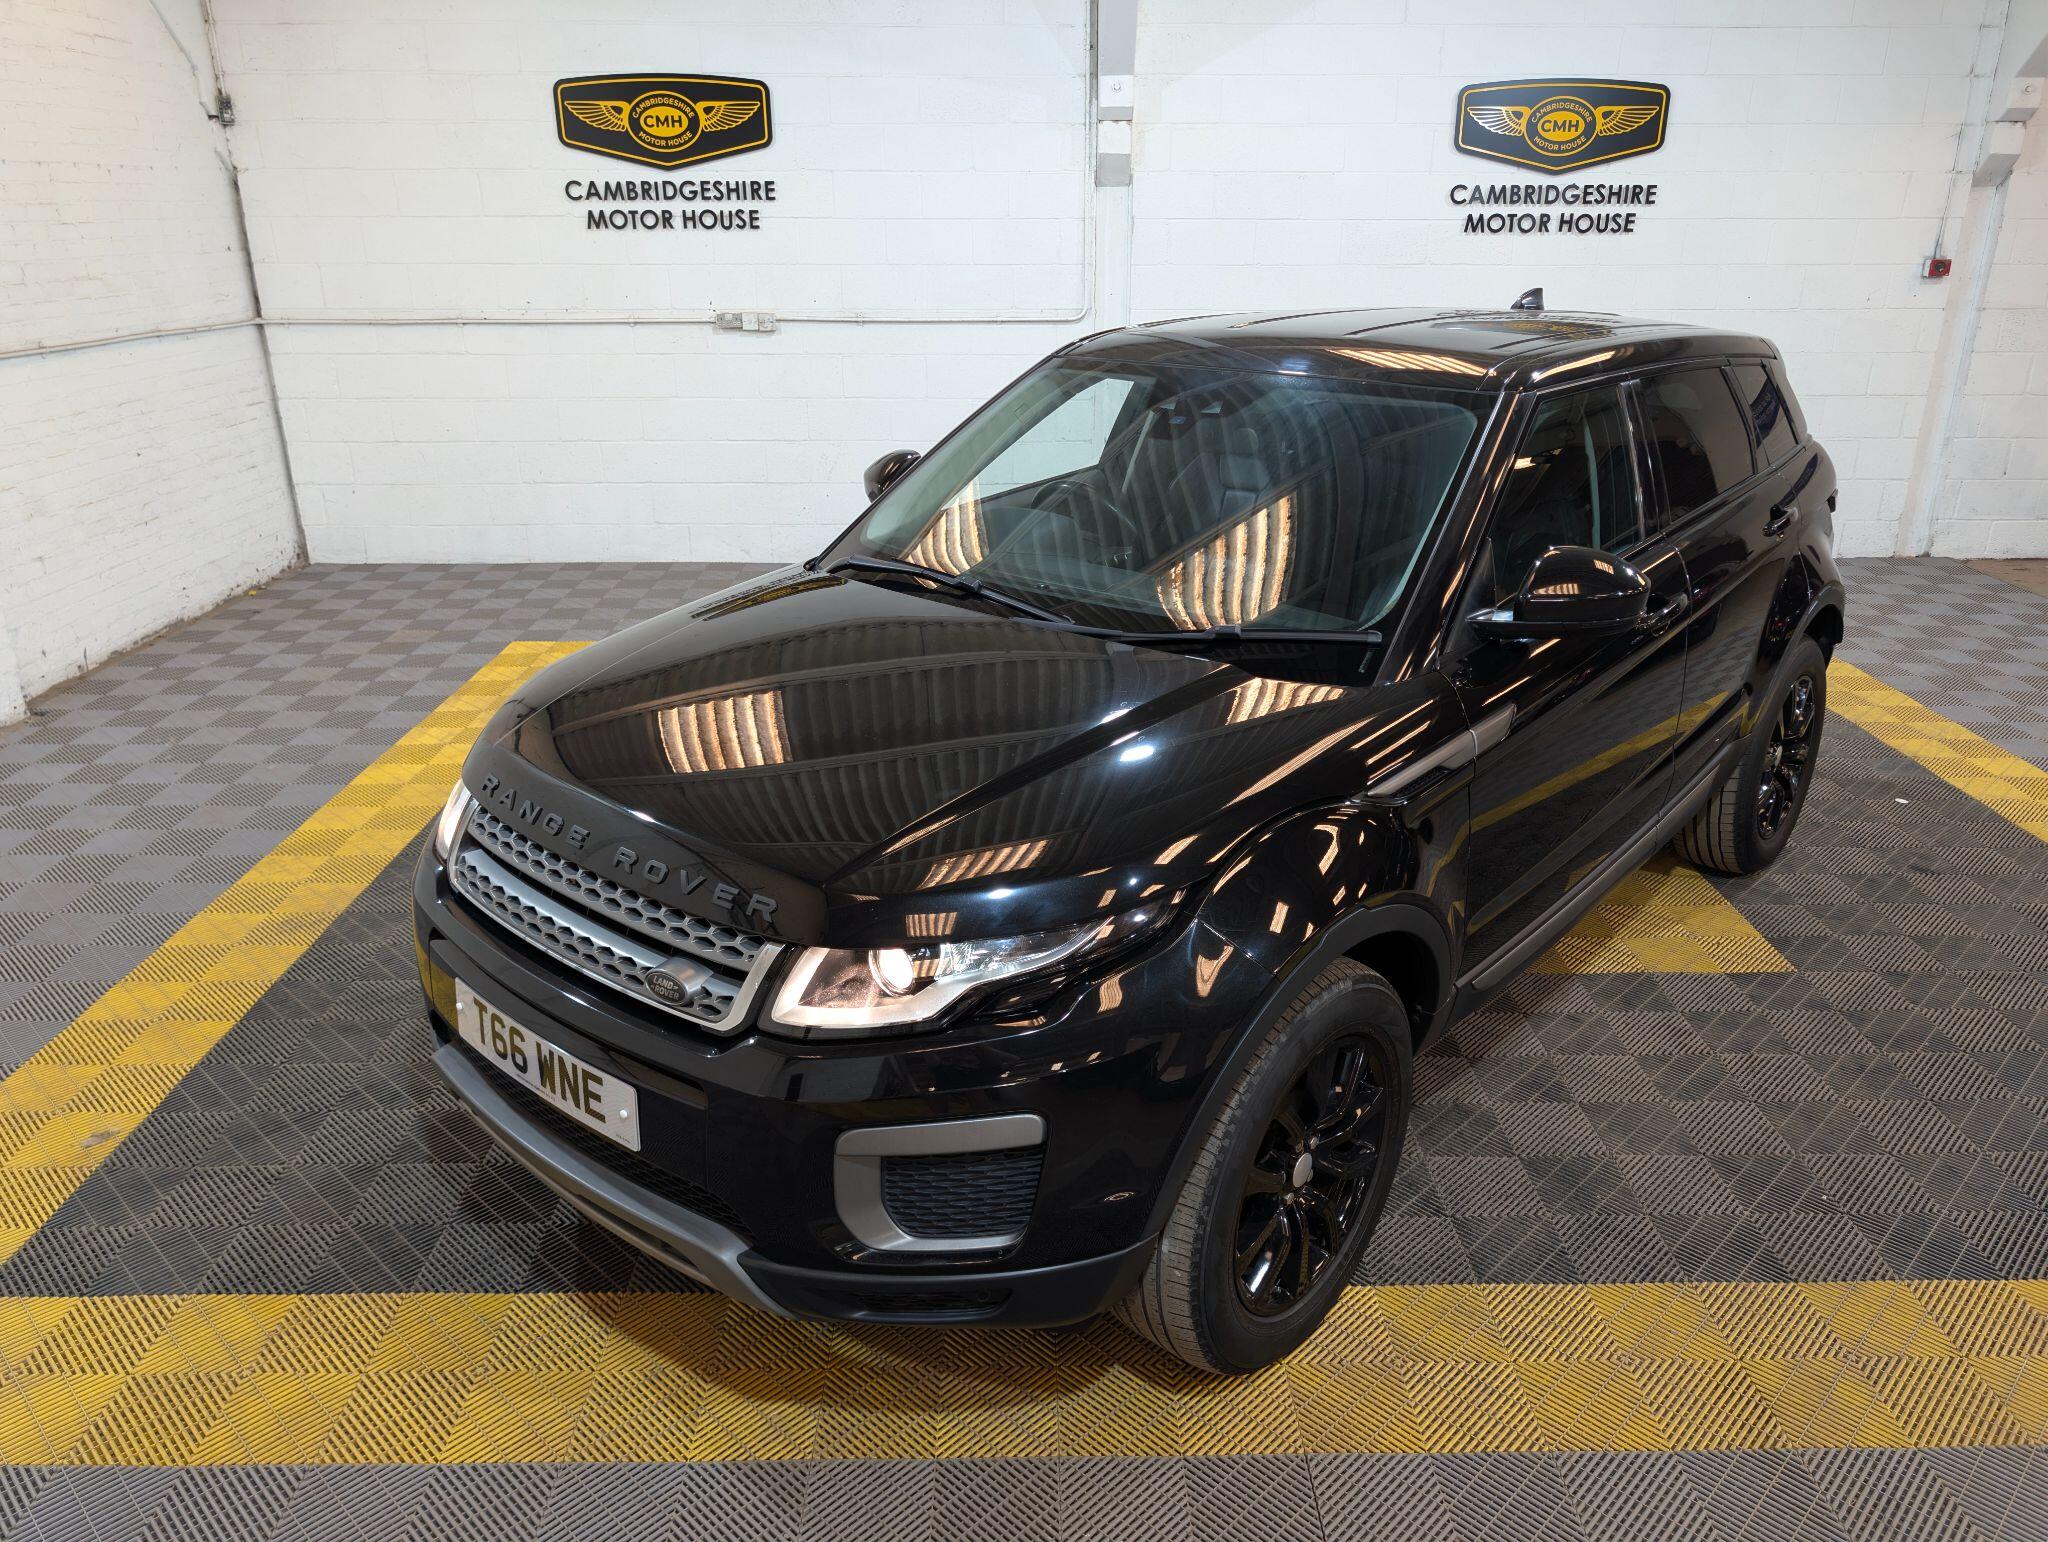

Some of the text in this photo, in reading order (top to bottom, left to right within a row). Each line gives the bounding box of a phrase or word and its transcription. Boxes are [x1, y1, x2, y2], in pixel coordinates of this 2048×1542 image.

[632, 97, 695, 119] CAMBRIDGESHIRE
[1531, 101, 1593, 123] CAMBRIDGESHIRE
[643, 114, 683, 129] CMH
[1540, 119, 1580, 133] CMH
[638, 130, 693, 147] MOTOR HOUSE
[1533, 135, 1587, 151] MOTOR HOUSE
[564, 180, 777, 201] CAMBRIDGESHIRE
[1450, 184, 1658, 205] CAMBRIDGESHIRE
[587, 209, 761, 230] MOTOR HOUSE
[1463, 213, 1637, 234] MOTOR HOUSE
[481, 772, 779, 922] RANGE ROVER
[653, 975, 674, 990] LAND
[655, 985, 680, 1001] ROVER
[473, 996, 606, 1124] T66 WNE
